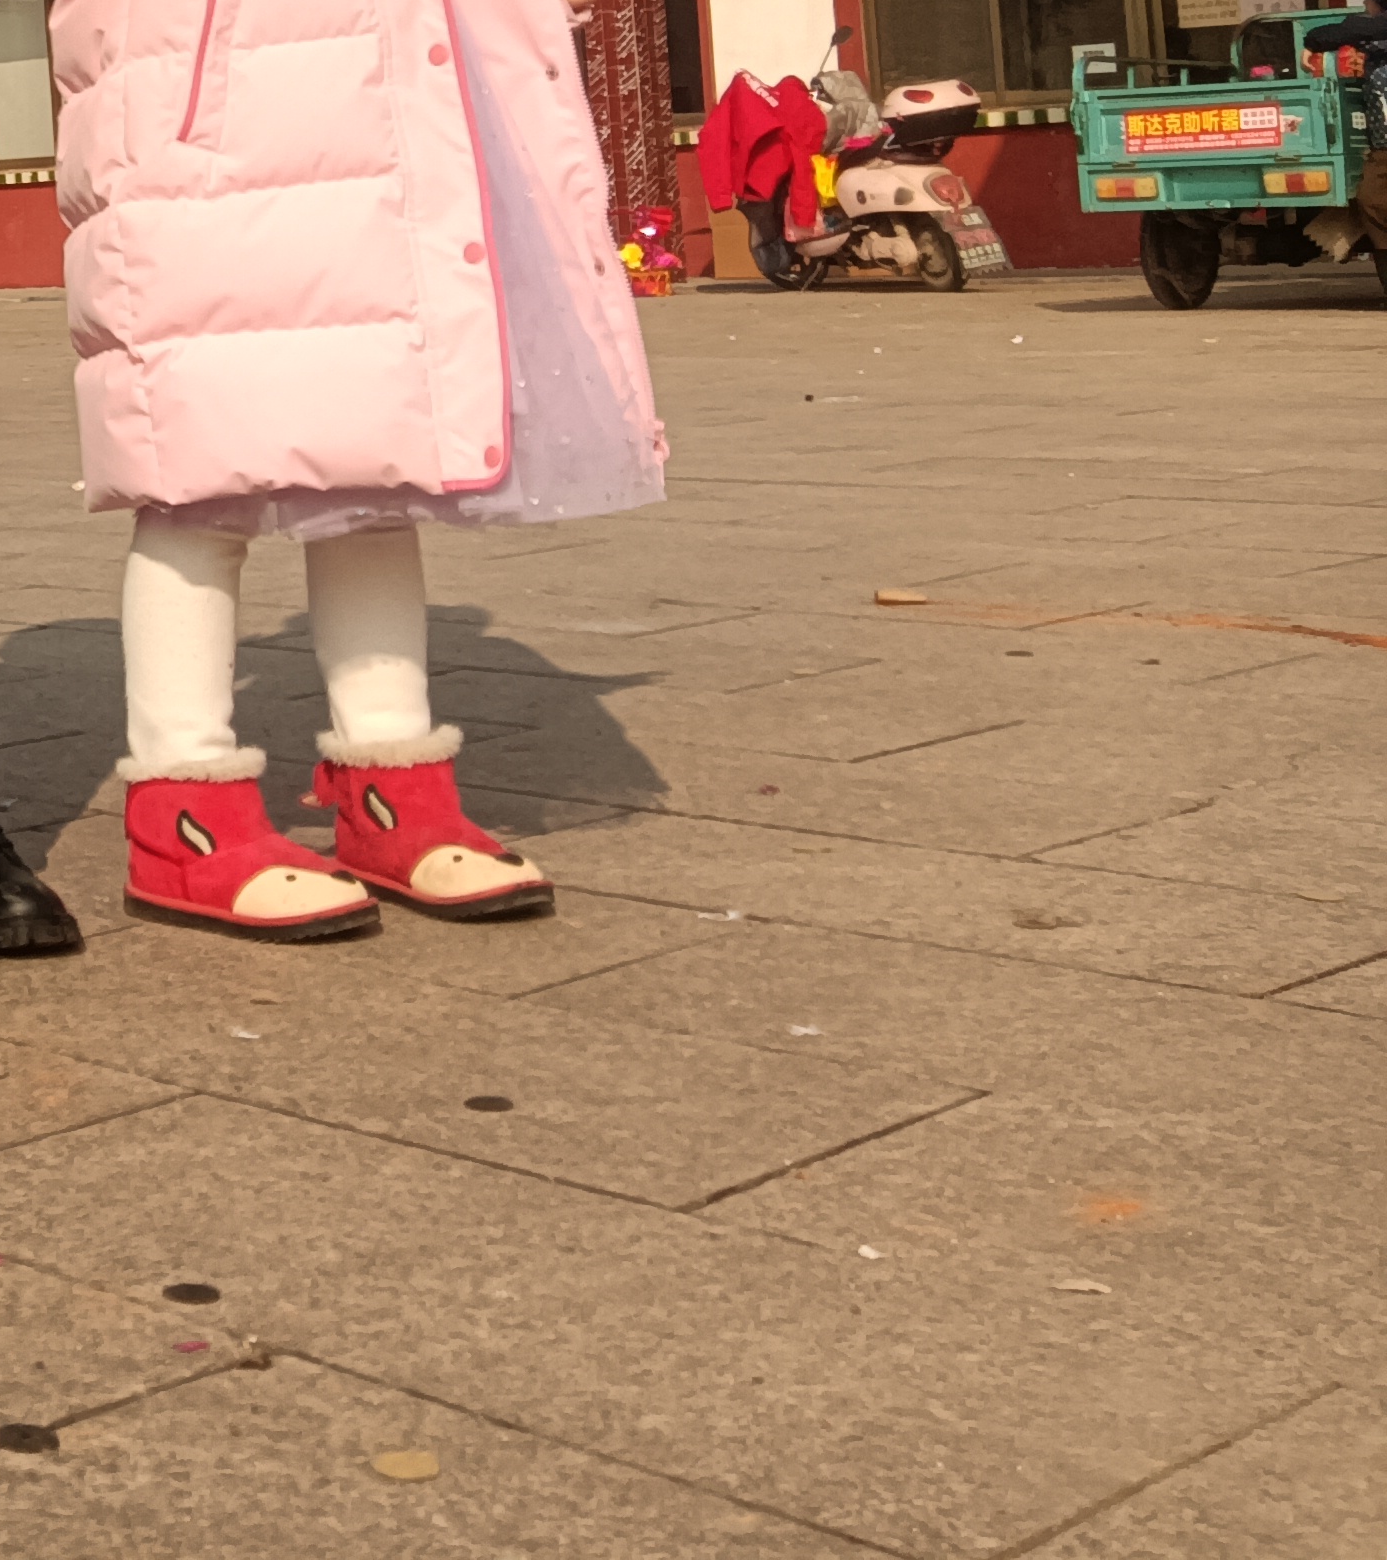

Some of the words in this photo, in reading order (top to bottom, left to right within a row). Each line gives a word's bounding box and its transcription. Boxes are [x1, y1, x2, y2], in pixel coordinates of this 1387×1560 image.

[1128, 109, 1240, 137] 斯达克助听器
